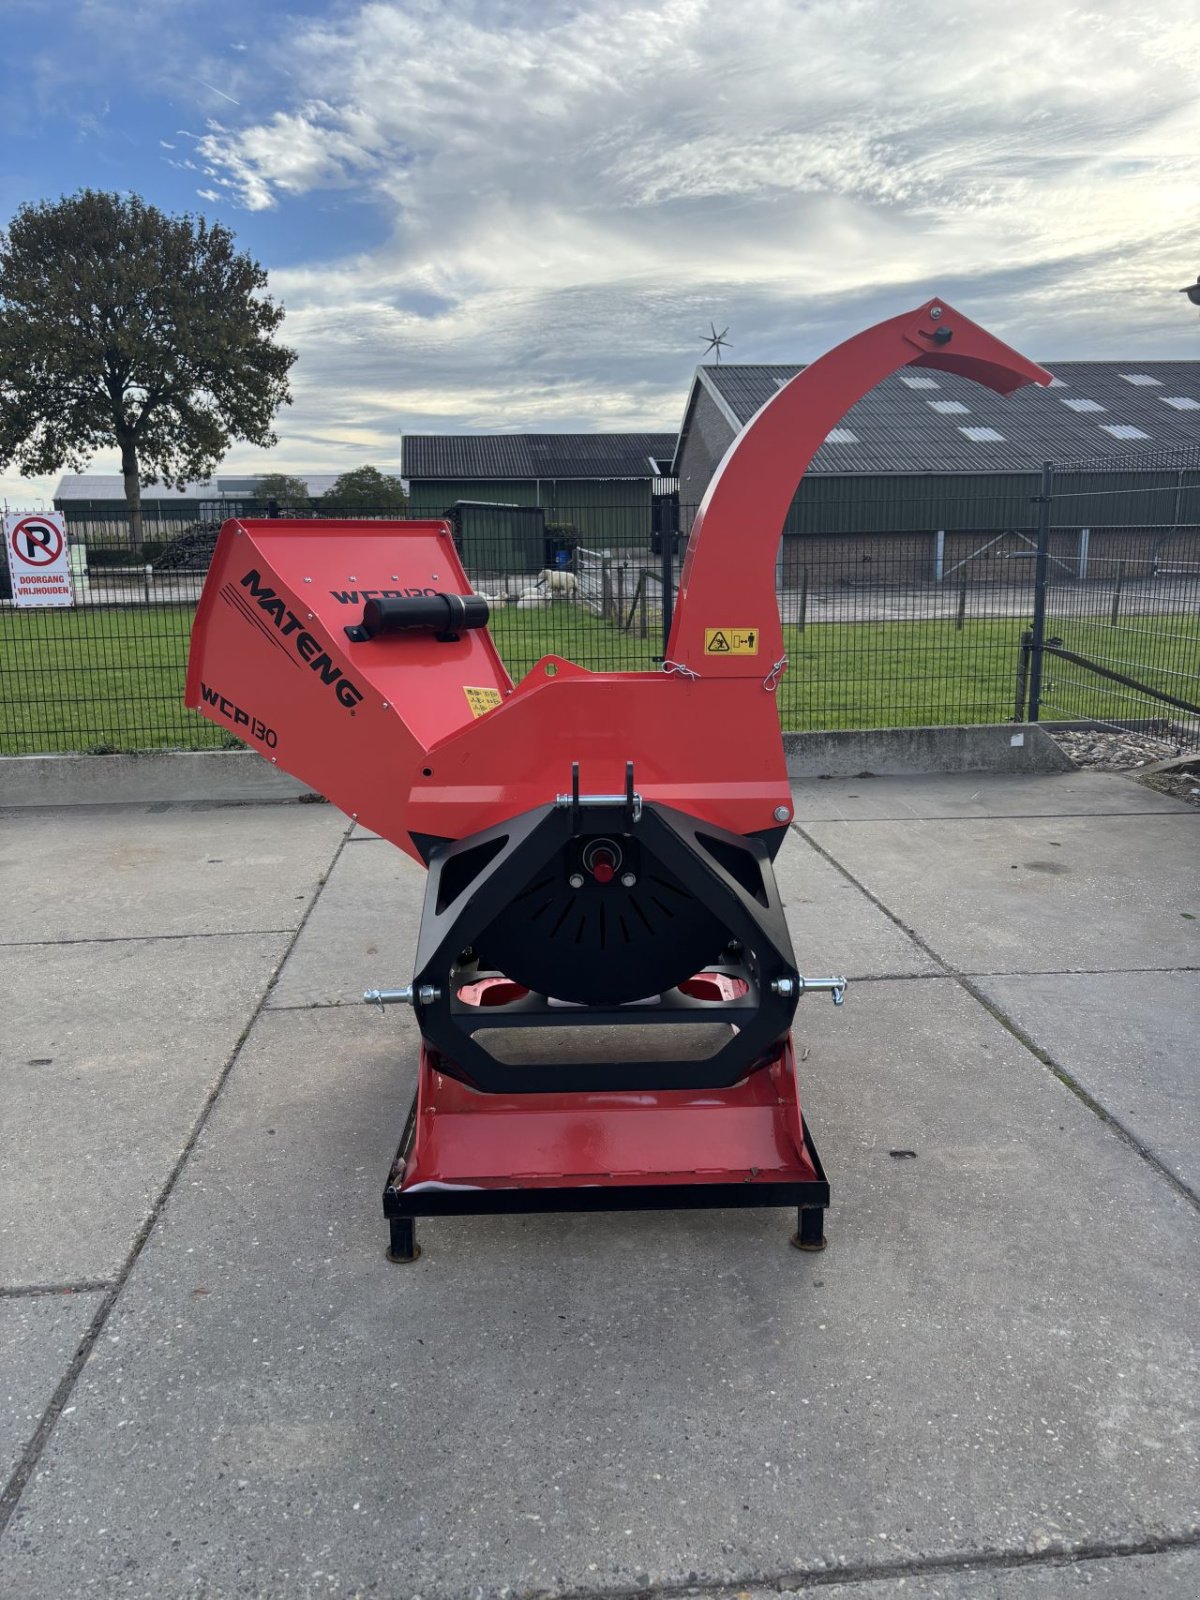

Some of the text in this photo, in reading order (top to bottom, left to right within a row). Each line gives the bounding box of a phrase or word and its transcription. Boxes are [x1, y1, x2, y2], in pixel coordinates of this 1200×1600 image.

[19, 575, 65, 584] DOORGANG
[17, 586, 69, 596] VRIJHOUDEN
[240, 568, 364, 708] MATENG
